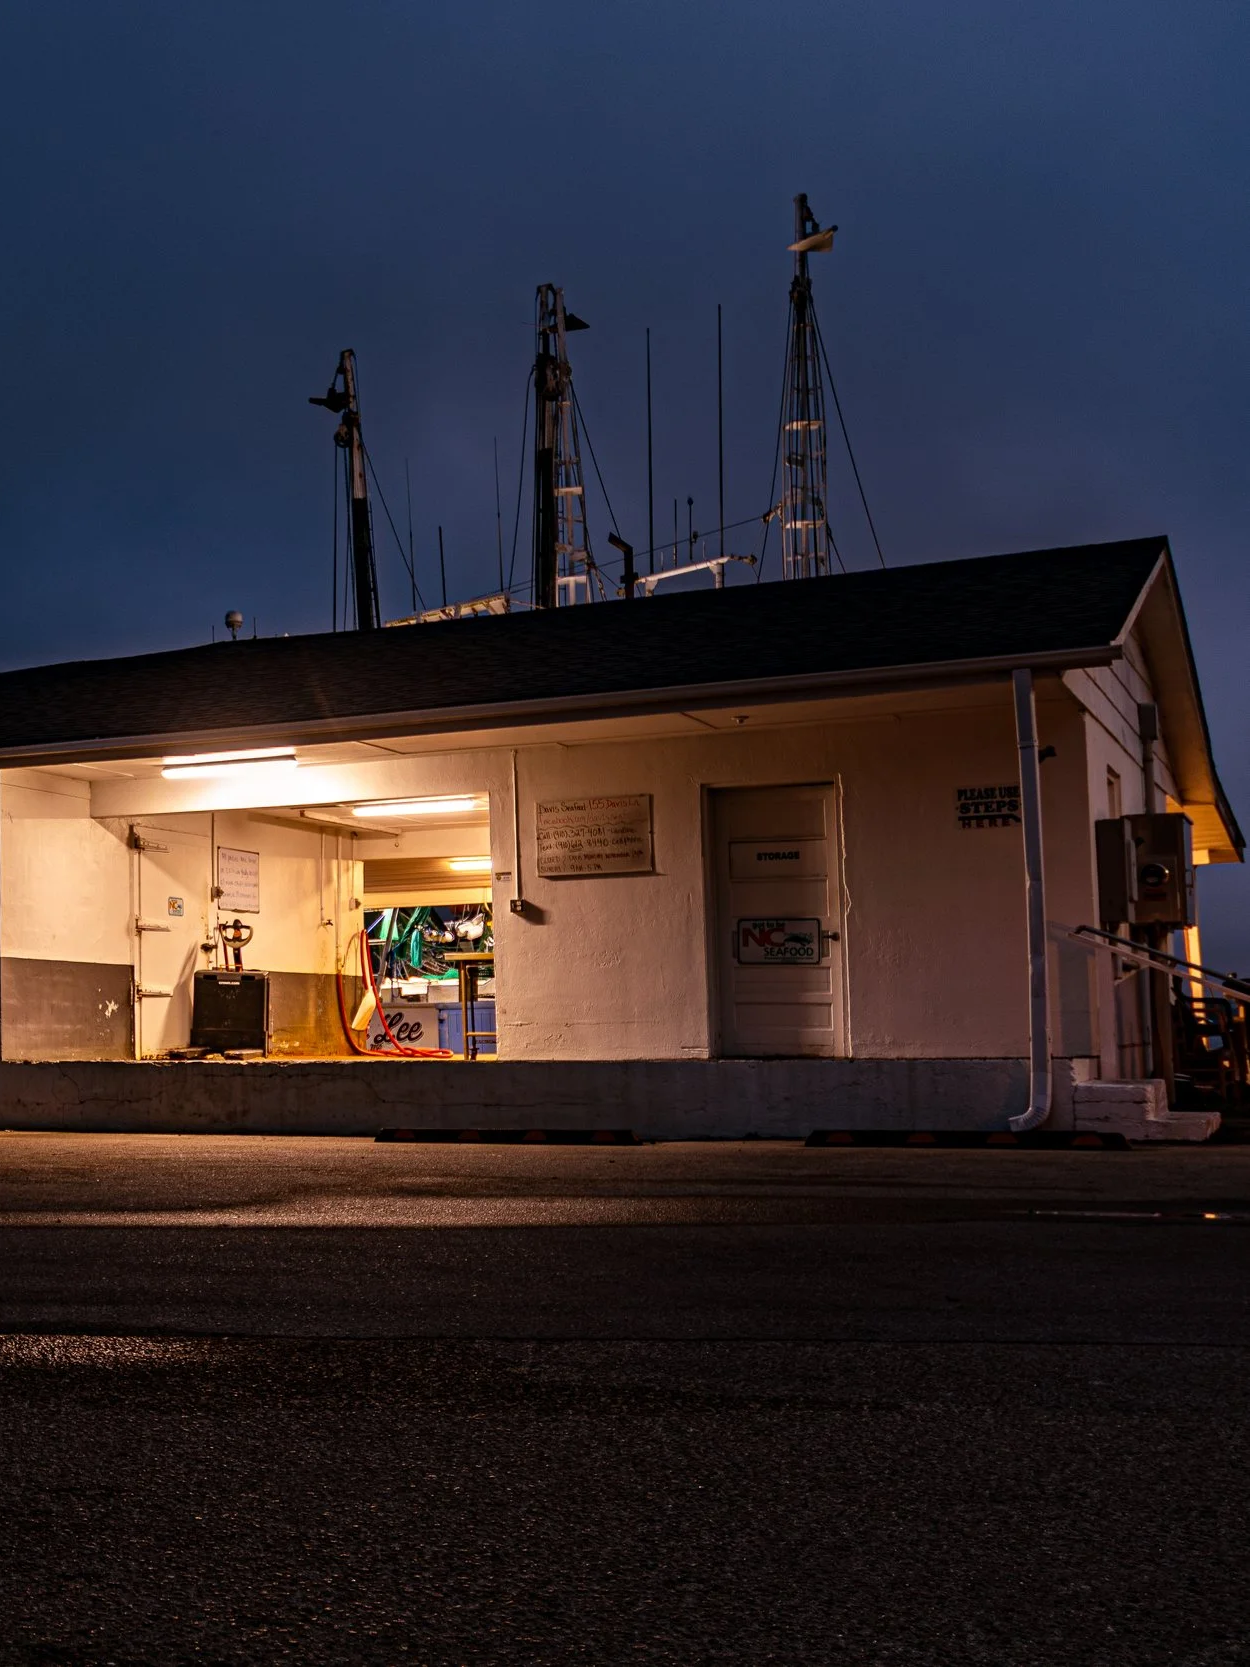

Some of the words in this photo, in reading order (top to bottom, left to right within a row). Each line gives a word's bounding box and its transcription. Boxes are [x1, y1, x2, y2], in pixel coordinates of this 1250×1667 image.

[957, 788, 997, 801] PLEASE
[999, 786, 1020, 798] USE
[959, 800, 1019, 814] STEPS
[962, 817, 1011, 828] HERE
[756, 851, 800, 862] STORAGE
[742, 928, 786, 947] NC
[764, 947, 814, 957] SEAFOOD
